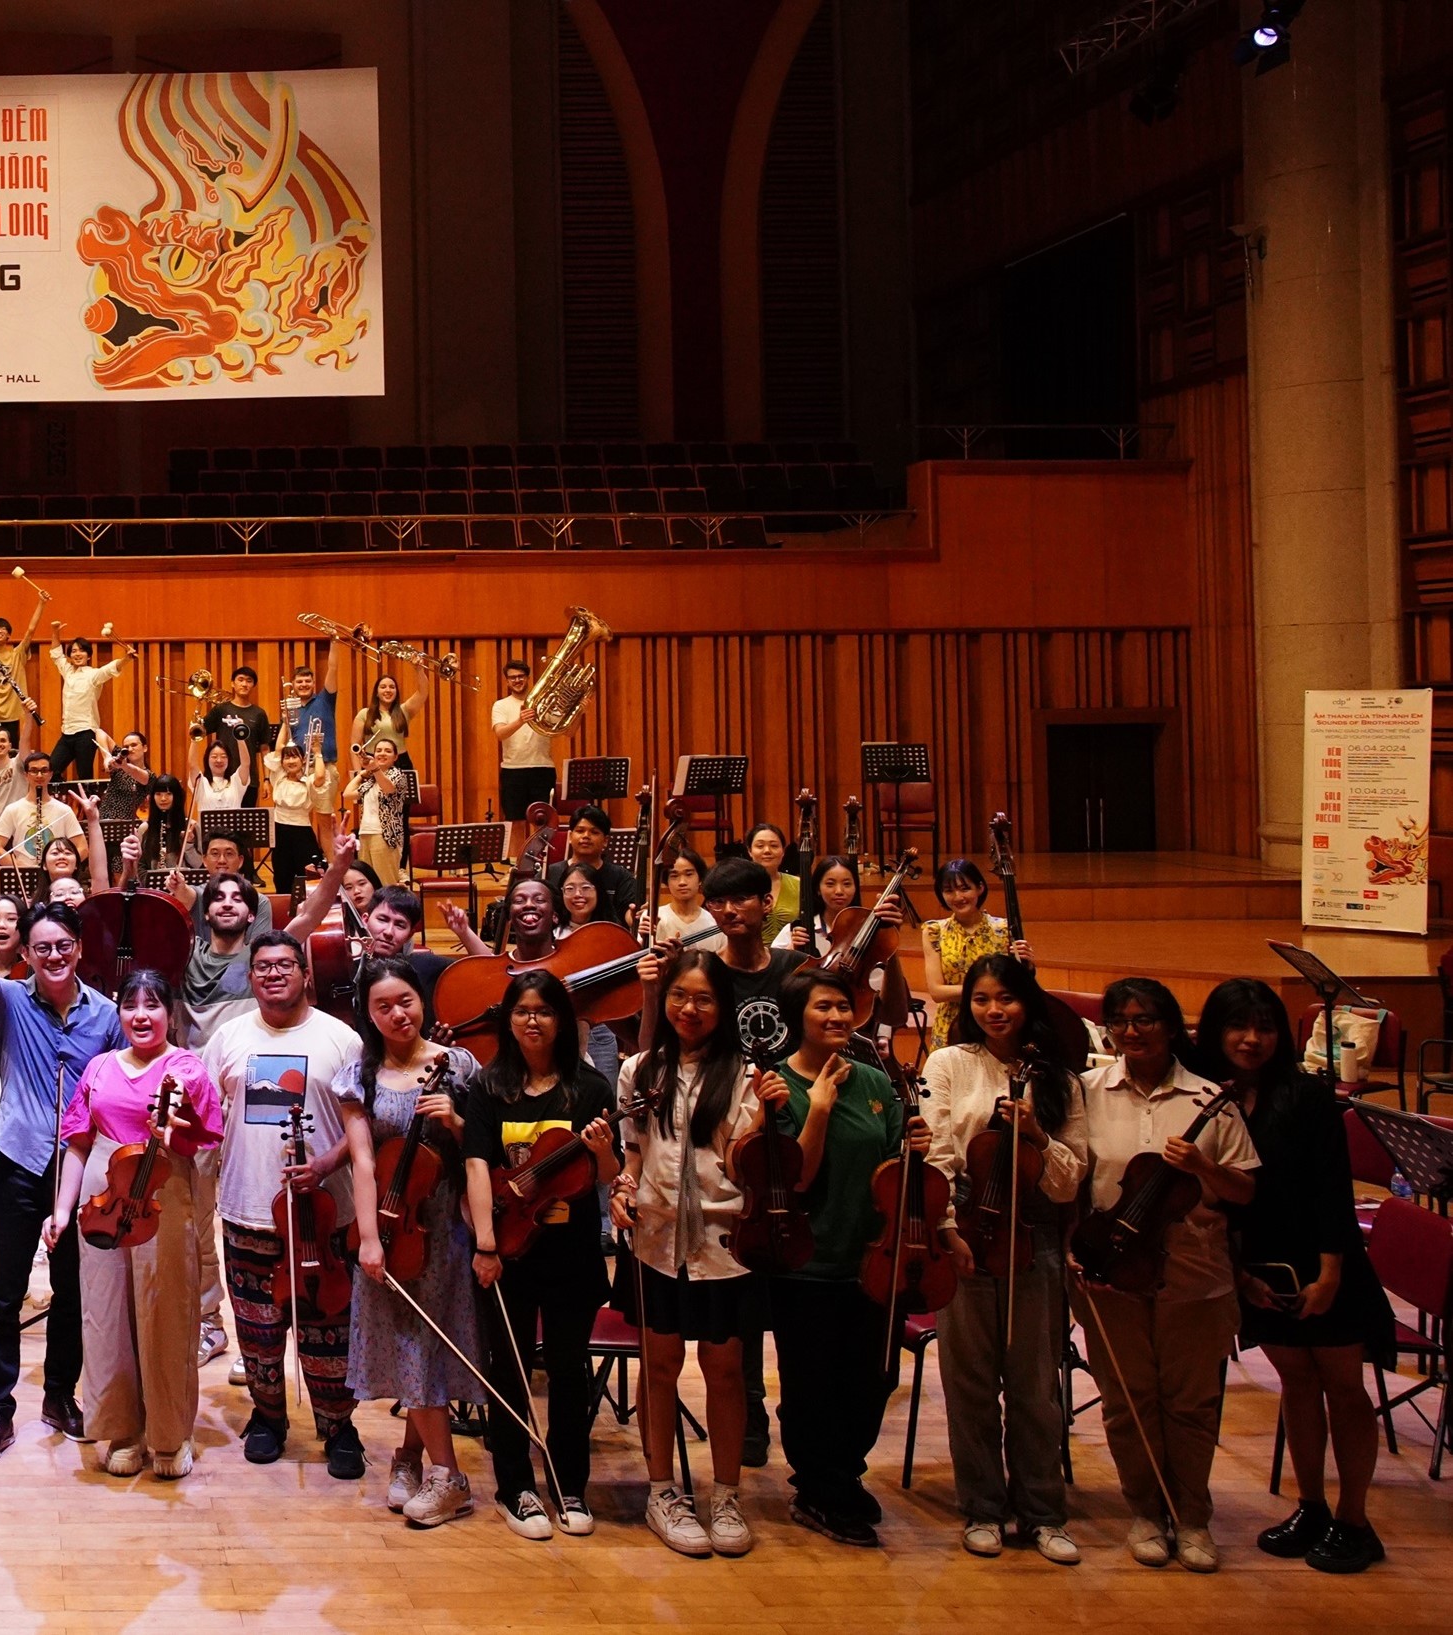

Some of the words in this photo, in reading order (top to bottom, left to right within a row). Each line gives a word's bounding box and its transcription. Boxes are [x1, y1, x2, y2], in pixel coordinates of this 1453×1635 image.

[1, 104, 47, 142] ĐÊM
[6, 374, 40, 383] HALL
[1350, 787, 1406, 795] 10.04.2024
